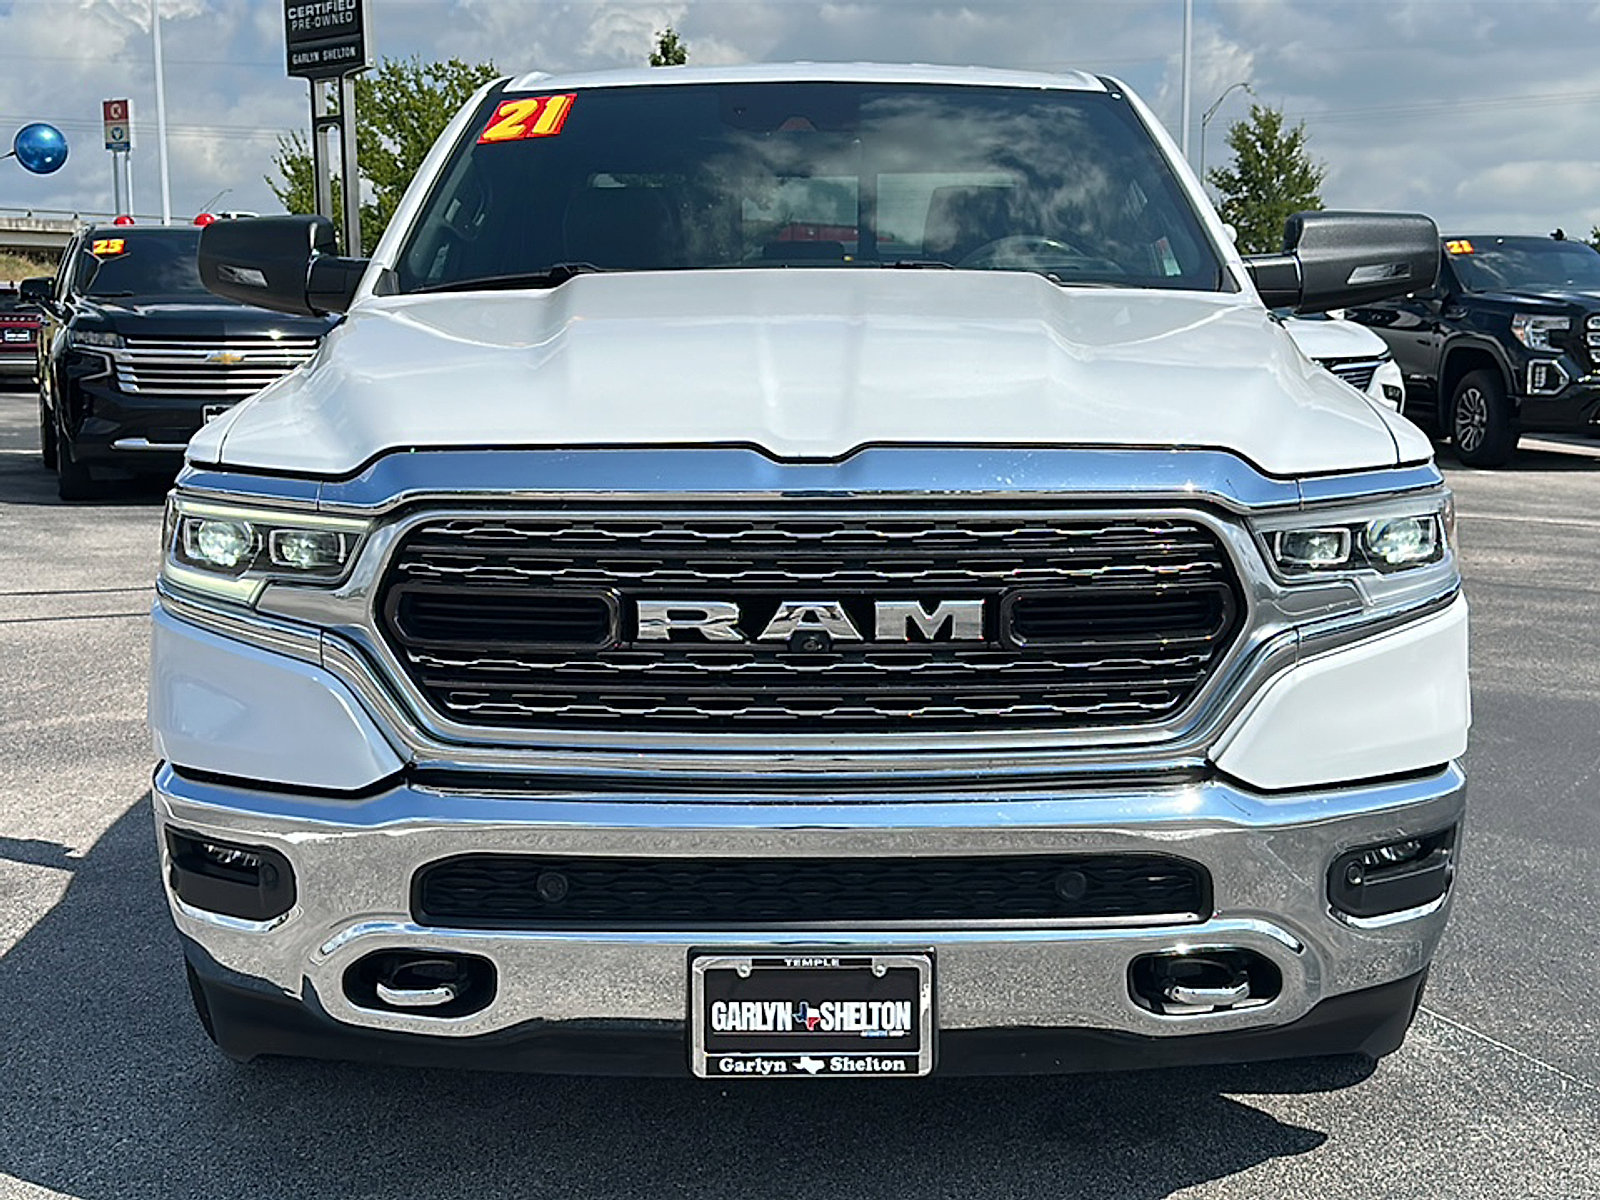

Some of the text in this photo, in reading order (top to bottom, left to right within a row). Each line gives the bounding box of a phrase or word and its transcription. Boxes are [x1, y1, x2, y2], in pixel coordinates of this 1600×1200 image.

[288, 0, 356, 19] CERTIFIED
[291, 11, 353, 31] PRE-OWNED
[292, 46, 356, 65] GARLYN SHELTON
[483, 96, 571, 141] 21
[93, 239, 125, 254] 23
[636, 600, 985, 641] RAM
[784, 958, 840, 967] TEMPLE
[711, 1001, 912, 1031] GARLYN SHELTON
[719, 1057, 906, 1075] Garlyn Shelton
